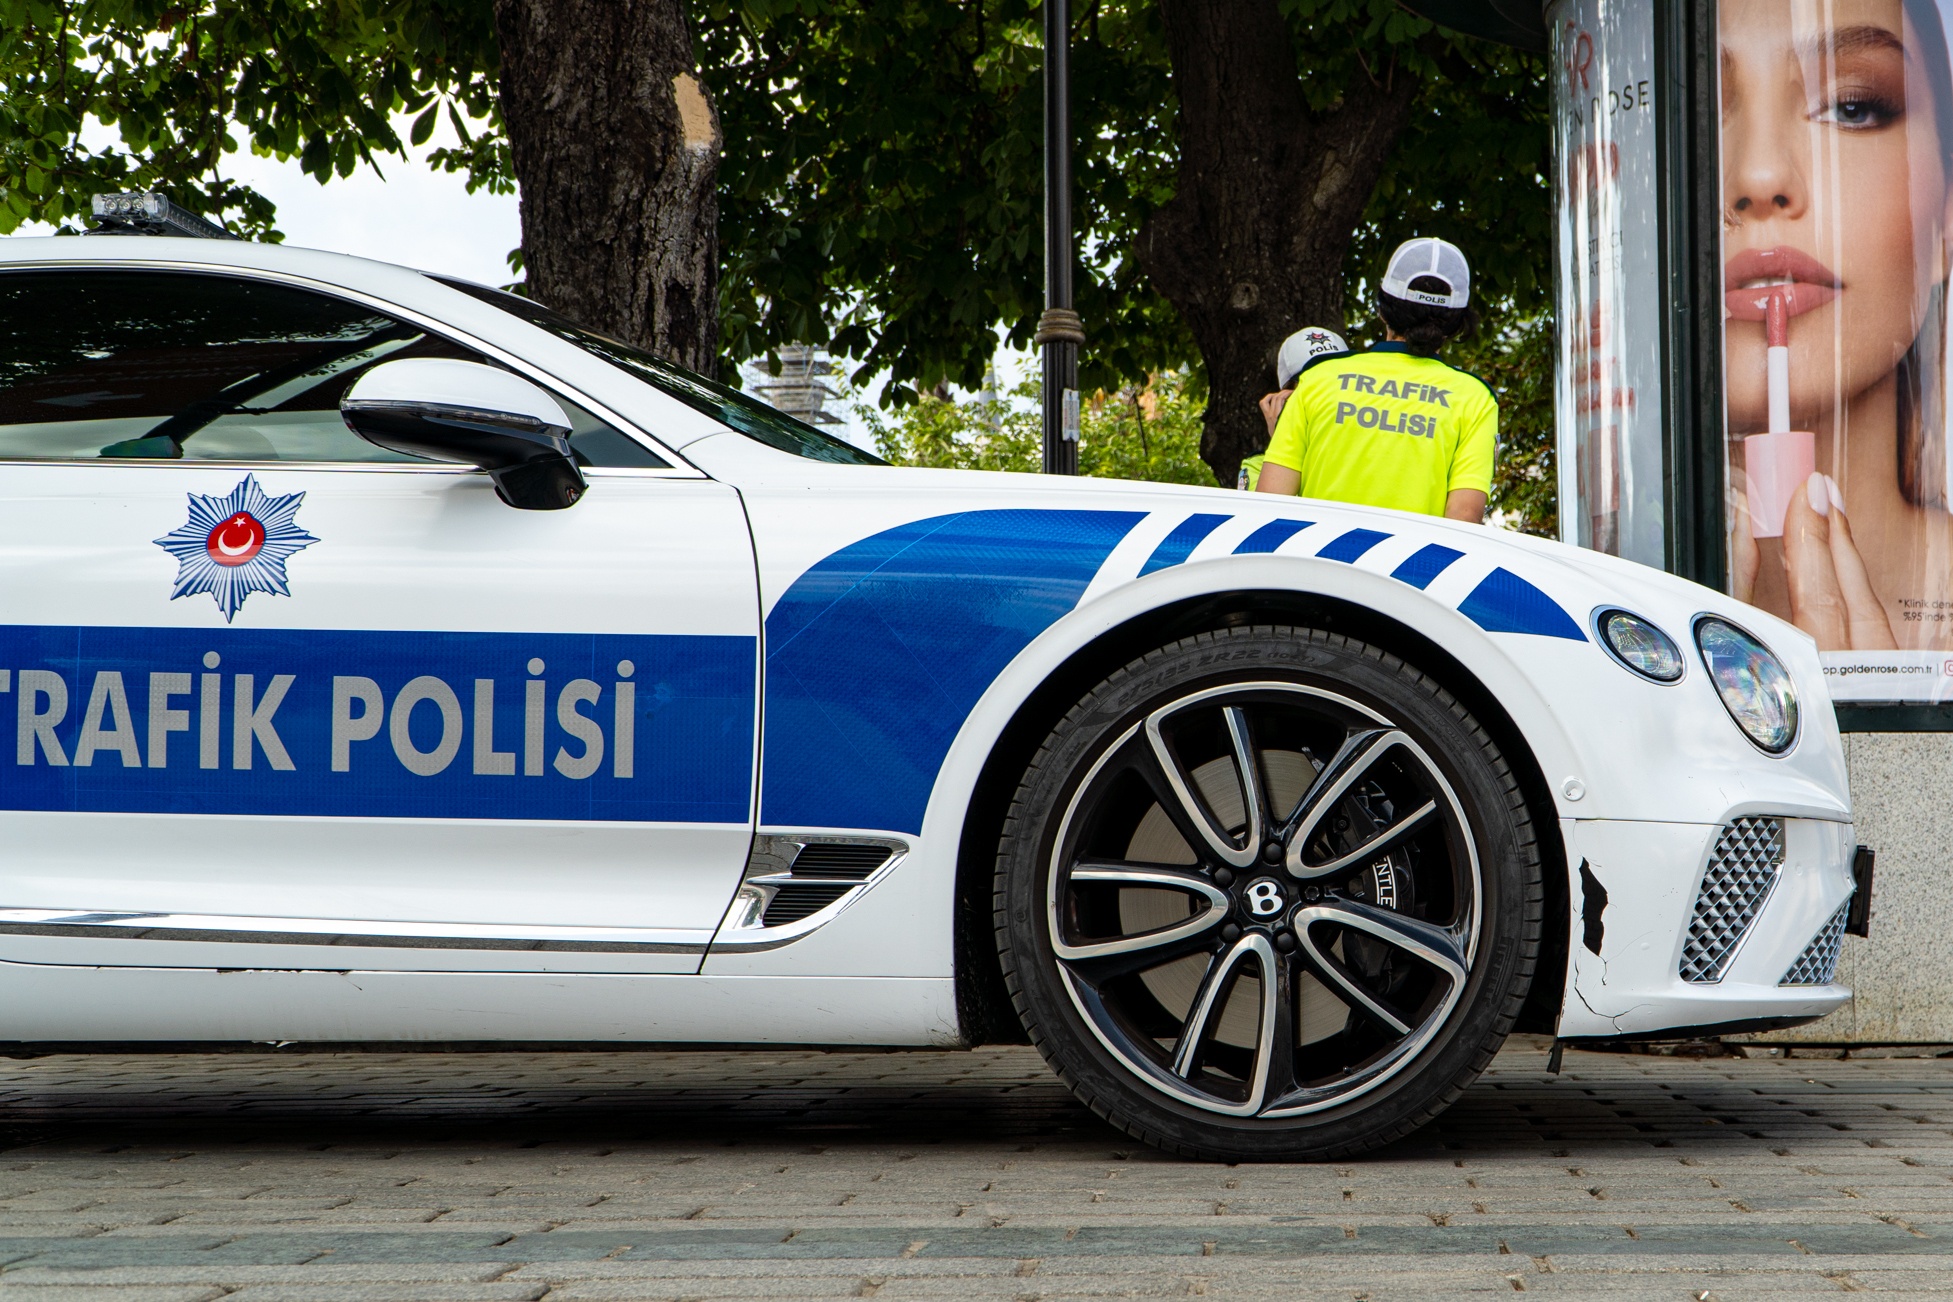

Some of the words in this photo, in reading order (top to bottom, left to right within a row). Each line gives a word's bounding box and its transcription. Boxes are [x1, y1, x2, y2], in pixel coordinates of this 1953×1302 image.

[331, 657, 636, 780] POLİSİ
[1246, 881, 1283, 915] B
[1375, 857, 1393, 906] NTLE
